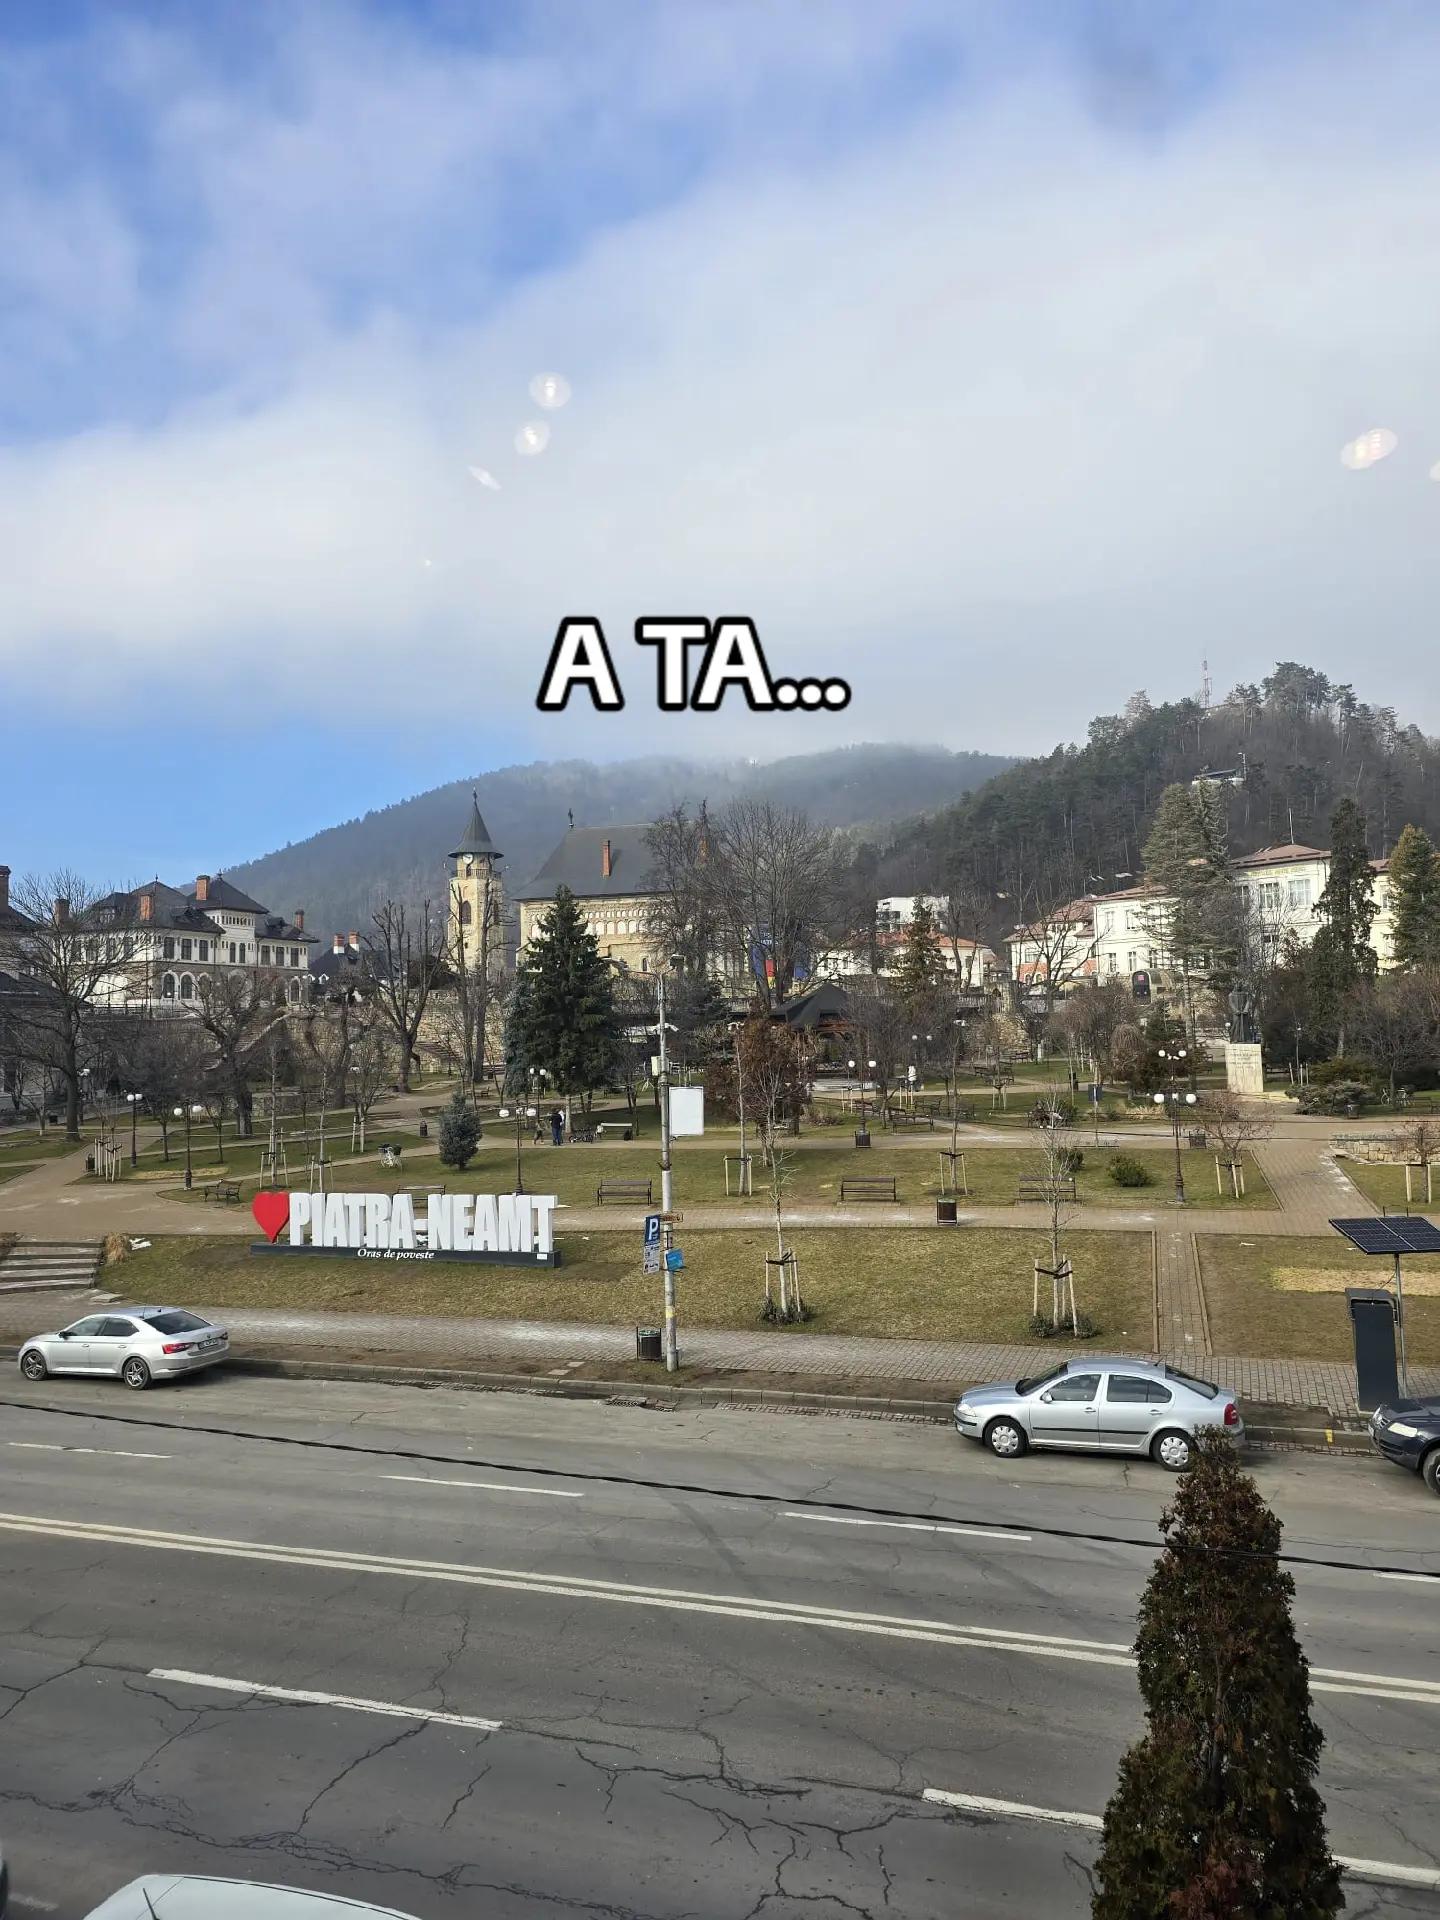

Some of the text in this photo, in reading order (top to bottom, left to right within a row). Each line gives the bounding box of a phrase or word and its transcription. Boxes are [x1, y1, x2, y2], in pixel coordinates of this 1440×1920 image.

[648, 1218, 659, 1240] P
[357, 1248, 435, 1260] Oras de poveste
